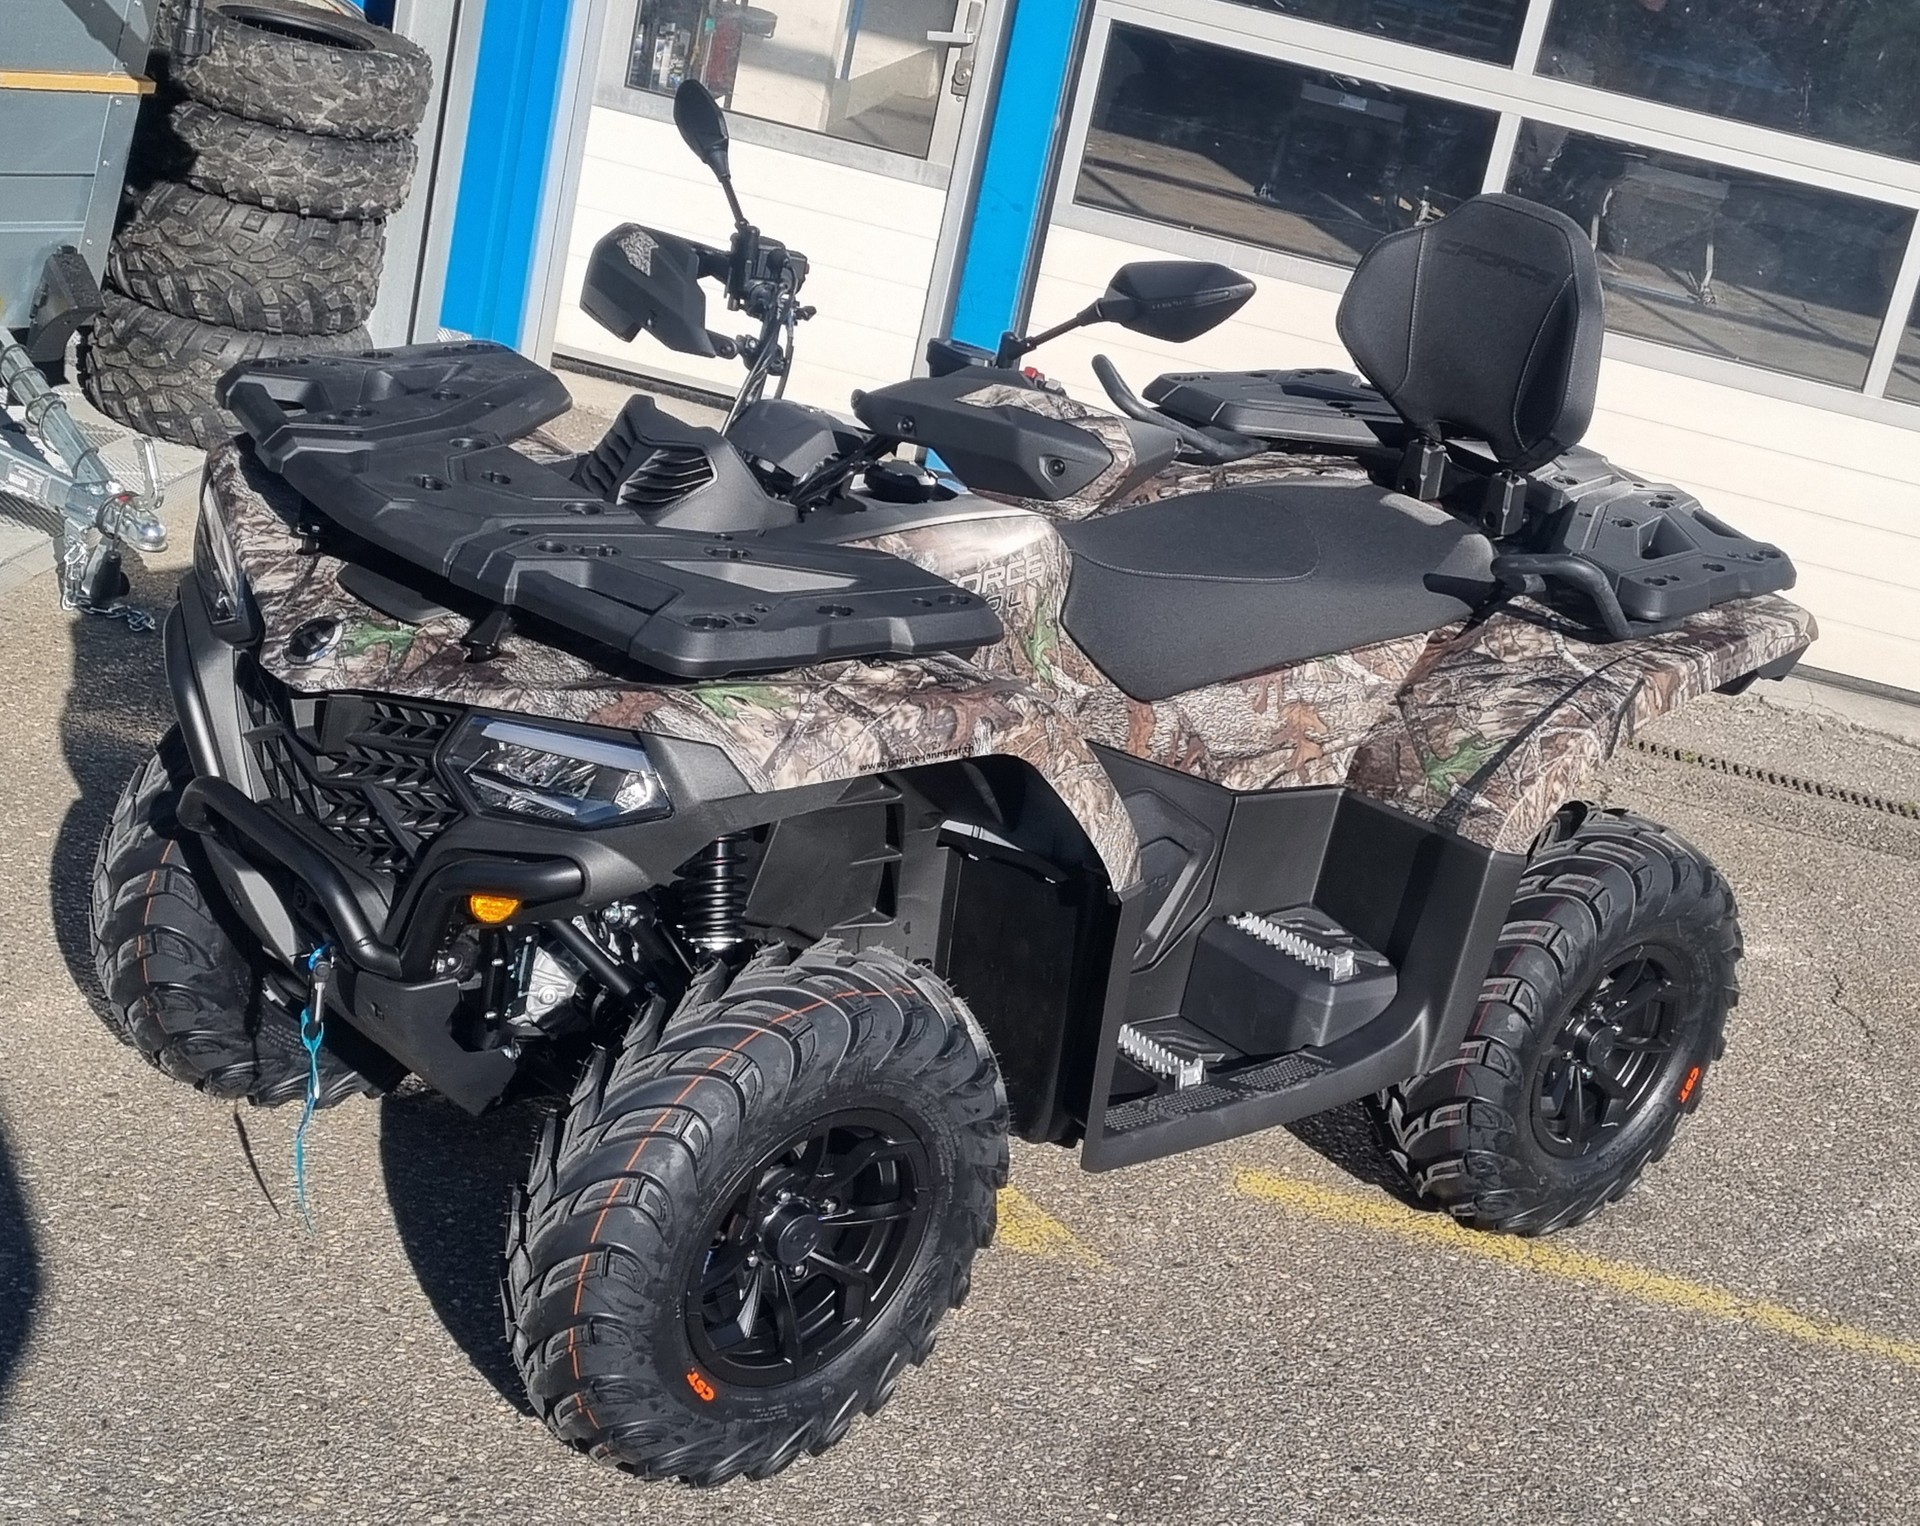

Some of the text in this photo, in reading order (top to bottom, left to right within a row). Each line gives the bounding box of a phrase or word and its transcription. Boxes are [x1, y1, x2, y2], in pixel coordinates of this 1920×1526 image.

[950, 554, 1043, 594] ORCE
[1680, 1067, 1699, 1104] CST
[686, 1372, 714, 1401] CST
